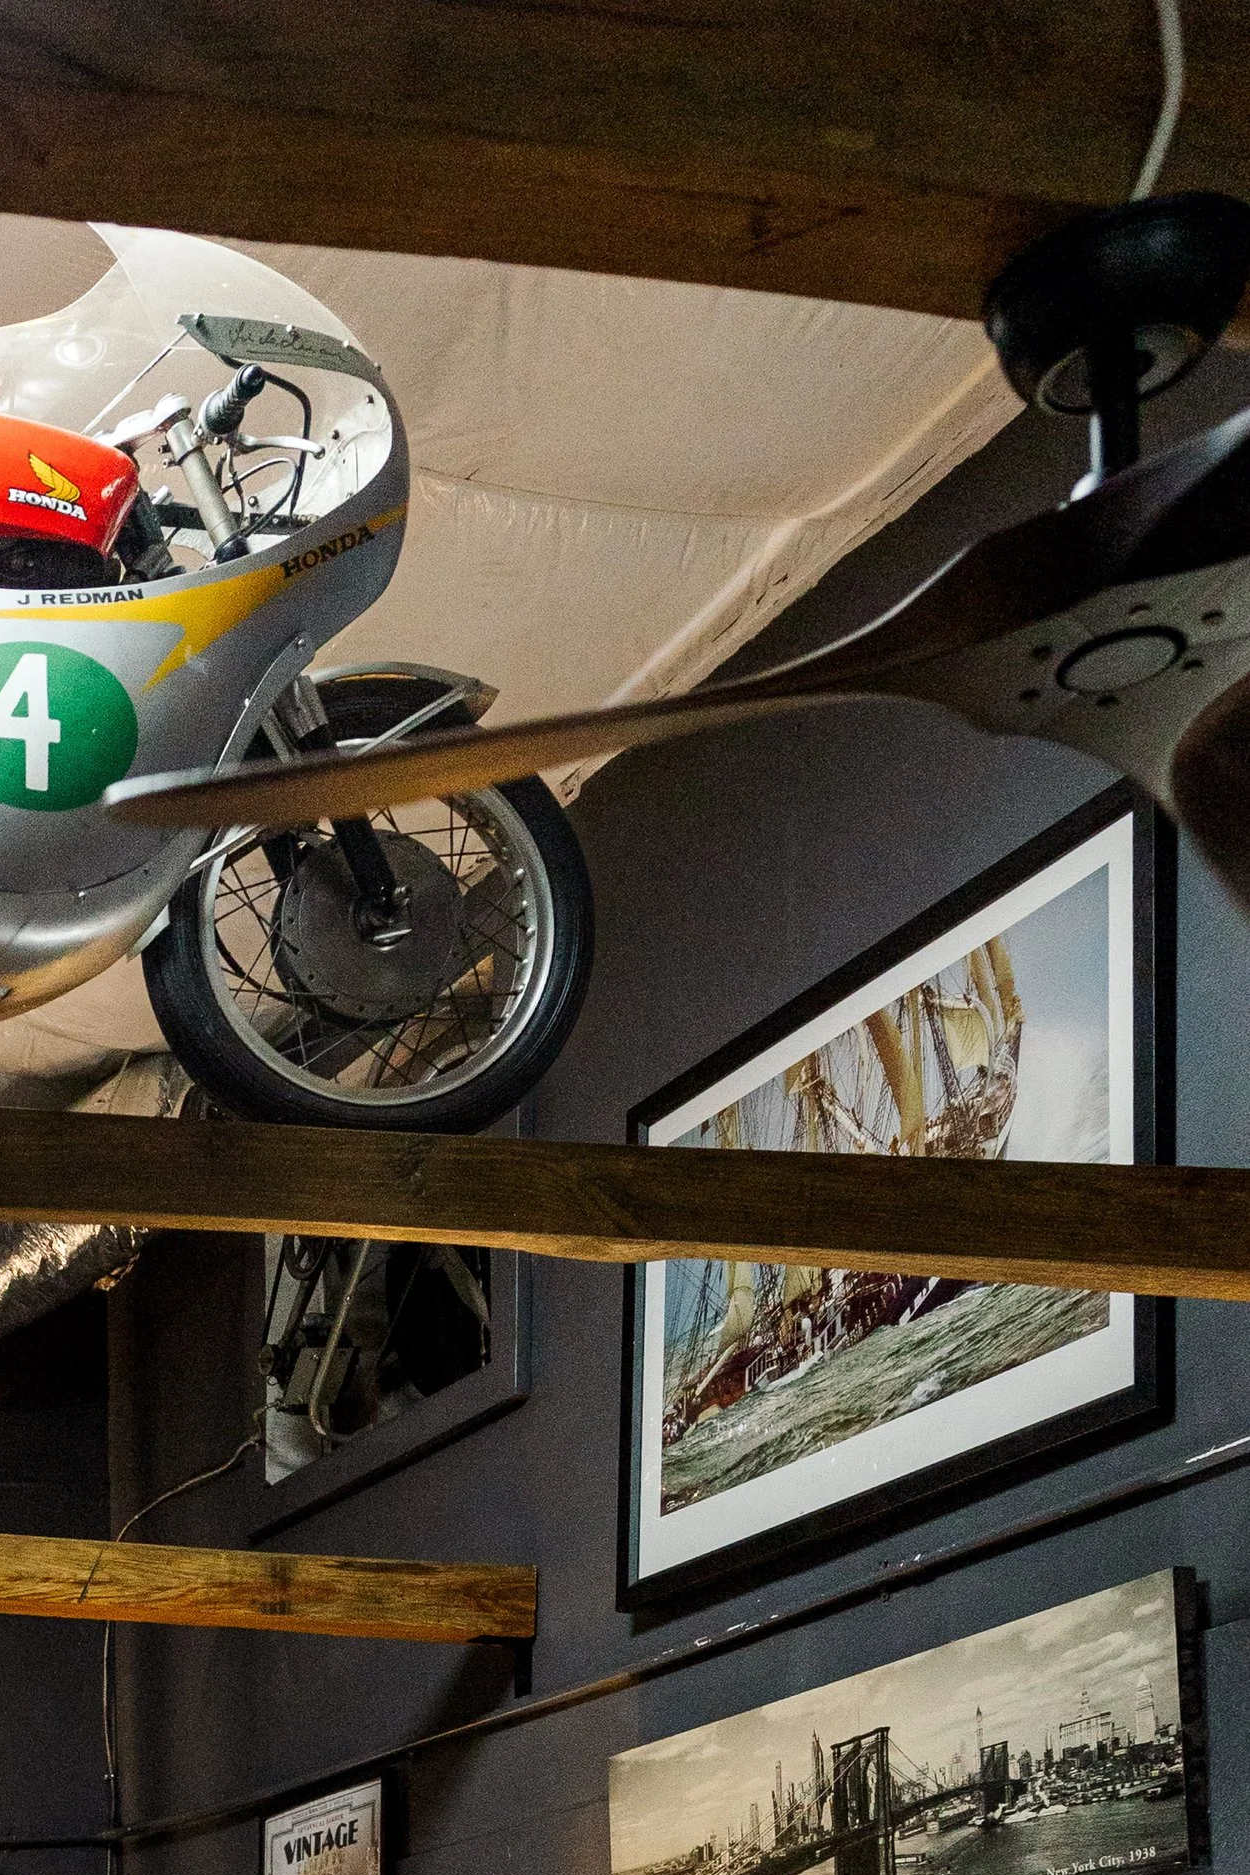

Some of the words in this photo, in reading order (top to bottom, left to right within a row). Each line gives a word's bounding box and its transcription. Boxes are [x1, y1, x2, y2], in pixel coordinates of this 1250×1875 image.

[8, 488, 88, 521] HONDA
[280, 525, 375, 578] HONDA
[17, 594, 30, 606] J
[41, 588, 144, 606] REDMAN
[283, 1818, 358, 1865] VINTAGE
[1070, 1859, 1096, 1875] York
[1130, 1846, 1156, 1862] 1938
